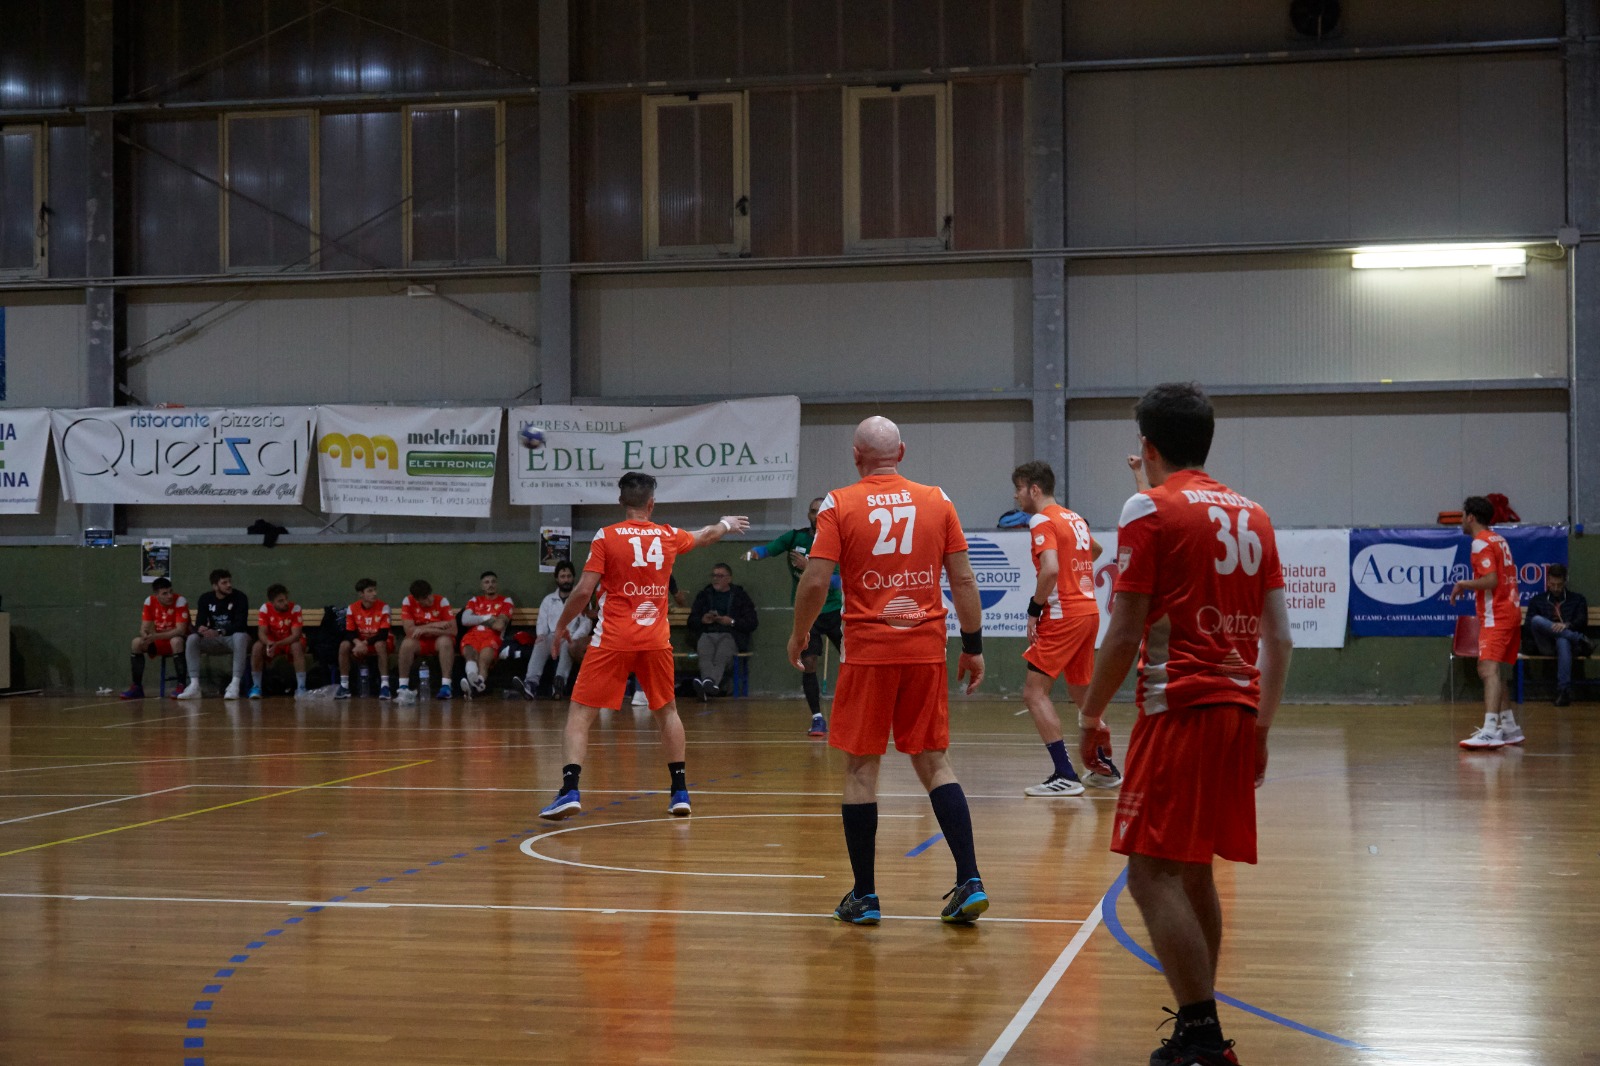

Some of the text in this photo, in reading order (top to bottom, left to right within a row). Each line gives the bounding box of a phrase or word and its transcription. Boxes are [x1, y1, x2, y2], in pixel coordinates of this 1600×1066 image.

[130, 411, 285, 434] ristorante pizzeria
[586, 421, 627, 432] EDILE
[407, 429, 496, 446] melchioni
[526, 438, 793, 471] EDIL EUROPA s.r.l.
[409, 459, 494, 469] ELETTRONICA
[0, 471, 29, 487] NA
[737, 474, 775, 484] ALCAMO
[866, 489, 913, 507] SCIRÈ
[615, 528, 662, 536] VACCARO
[868, 505, 916, 556] 27
[1069, 520, 1090, 550] 18
[1207, 505, 1262, 576] 36
[628, 536, 665, 571] 14
[985, 613, 1002, 621] 329
[1303, 620, 1318, 631] (TP)
